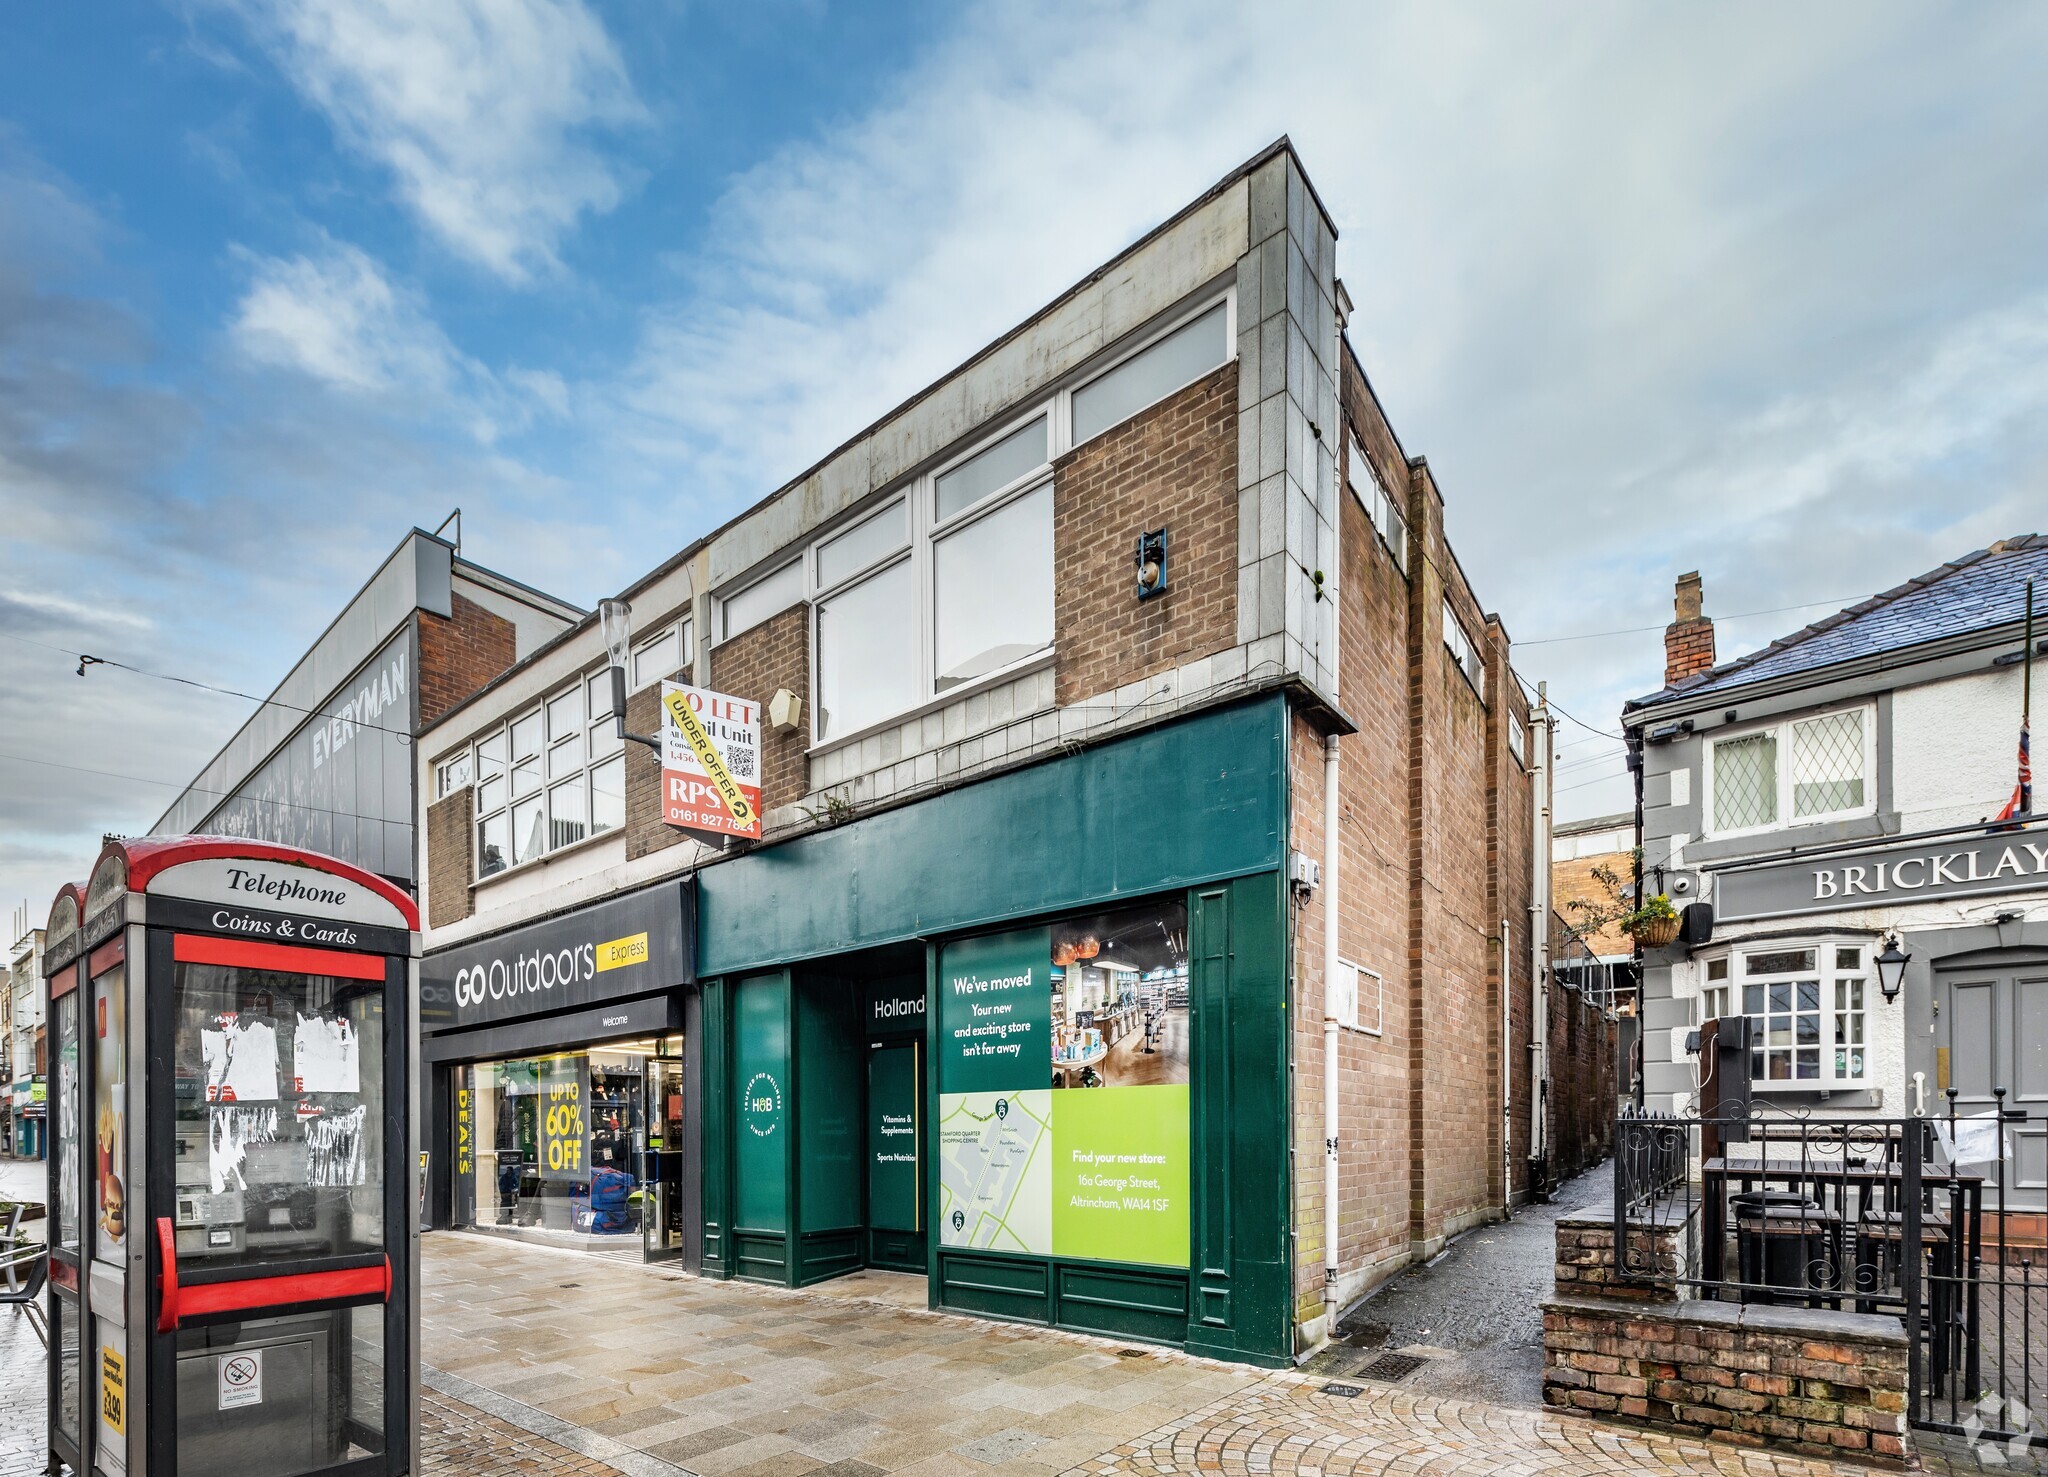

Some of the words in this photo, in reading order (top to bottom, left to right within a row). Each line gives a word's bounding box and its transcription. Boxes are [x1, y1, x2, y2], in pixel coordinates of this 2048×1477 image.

[313, 653, 405, 770] EVERYMAN
[712, 698, 754, 725] LET
[722, 724, 753, 746] Unit
[671, 751, 694, 763] 1,456
[672, 699, 707, 752] UNDER
[705, 752, 736, 799] OFFER
[671, 807, 698, 822] 0161
[701, 812, 723, 828] 927
[226, 868, 346, 905] Telephone
[211, 910, 271, 935] Coins
[276, 919, 296, 937] &
[300, 922, 357, 946] Cards
[455, 964, 486, 1008] GO
[489, 942, 595, 1000] Outdoors
[611, 940, 645, 963] Express
[953, 975, 988, 995] We've
[990, 967, 1032, 991] moved
[874, 994, 926, 1018] Holland
[971, 1003, 992, 1016] Your
[994, 1004, 1012, 1015] new
[602, 1013, 629, 1028] Welcome
[954, 1023, 971, 1038] and
[972, 1022, 1007, 1038] exciting
[1008, 1022, 1031, 1033] store
[963, 1042, 980, 1056] isn't
[982, 1041, 995, 1055] far
[996, 1043, 1021, 1058] away
[755, 1072, 766, 1080] FOR
[550, 1083, 564, 1101] UP
[564, 1082, 579, 1101] TO
[546, 1104, 584, 1137] 60%
[882, 1115, 906, 1123] Vitamins
[906, 1114, 912, 1123] &
[459, 1089, 469, 1175] DEALS
[750, 1124, 764, 1137] SINCE
[881, 1125, 914, 1136] Supplements
[549, 1139, 582, 1170] OFF
[877, 1152, 893, 1163] Sports
[894, 1153, 916, 1161] Nutritio
[1072, 1150, 1093, 1163] Find
[1095, 1154, 1116, 1167] your
[1117, 1154, 1137, 1163] new
[1138, 1153, 1166, 1164] store:
[1078, 1174, 1093, 1186] 16a
[1094, 1174, 1127, 1192] George
[1129, 1175, 1160, 1191] Street,
[1070, 1195, 1121, 1211] Altrincham,
[1122, 1197, 1151, 1210] WA14
[1152, 1198, 1170, 1211] 1SF
[233, 1384, 259, 1393] SMOKING
[103, 1391, 121, 1426] £3.99
